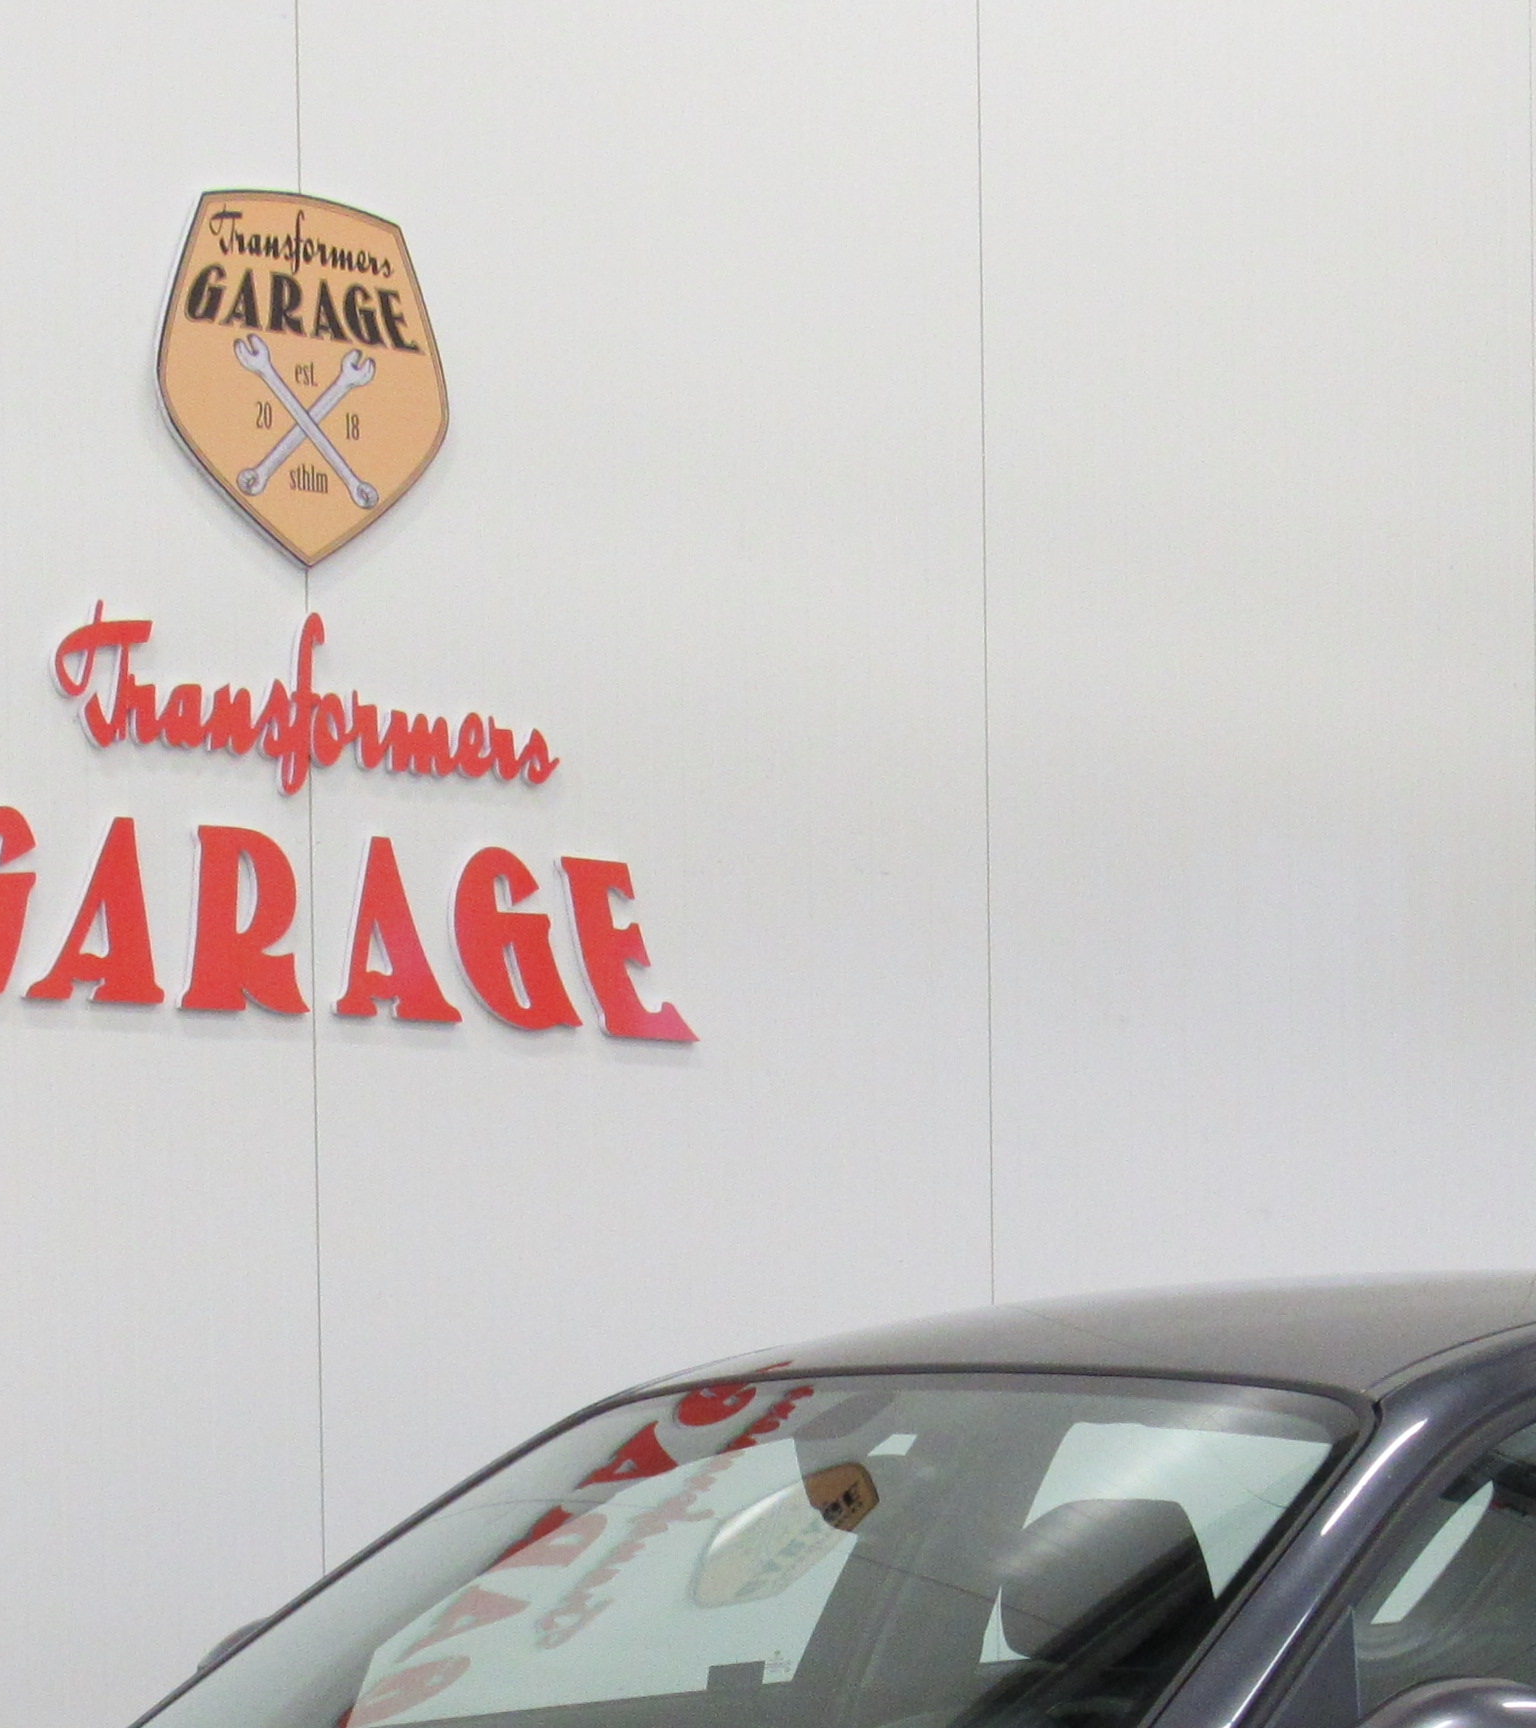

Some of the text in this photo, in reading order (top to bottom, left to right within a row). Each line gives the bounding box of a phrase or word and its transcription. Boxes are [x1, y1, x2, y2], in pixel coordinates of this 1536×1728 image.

[209, 203, 395, 278] Transformers
[184, 262, 426, 356] GARAGE
[294, 360, 318, 387] est.
[255, 400, 361, 441] 20 18
[288, 463, 329, 494] sthlm
[50, 600, 560, 797] Transformers
